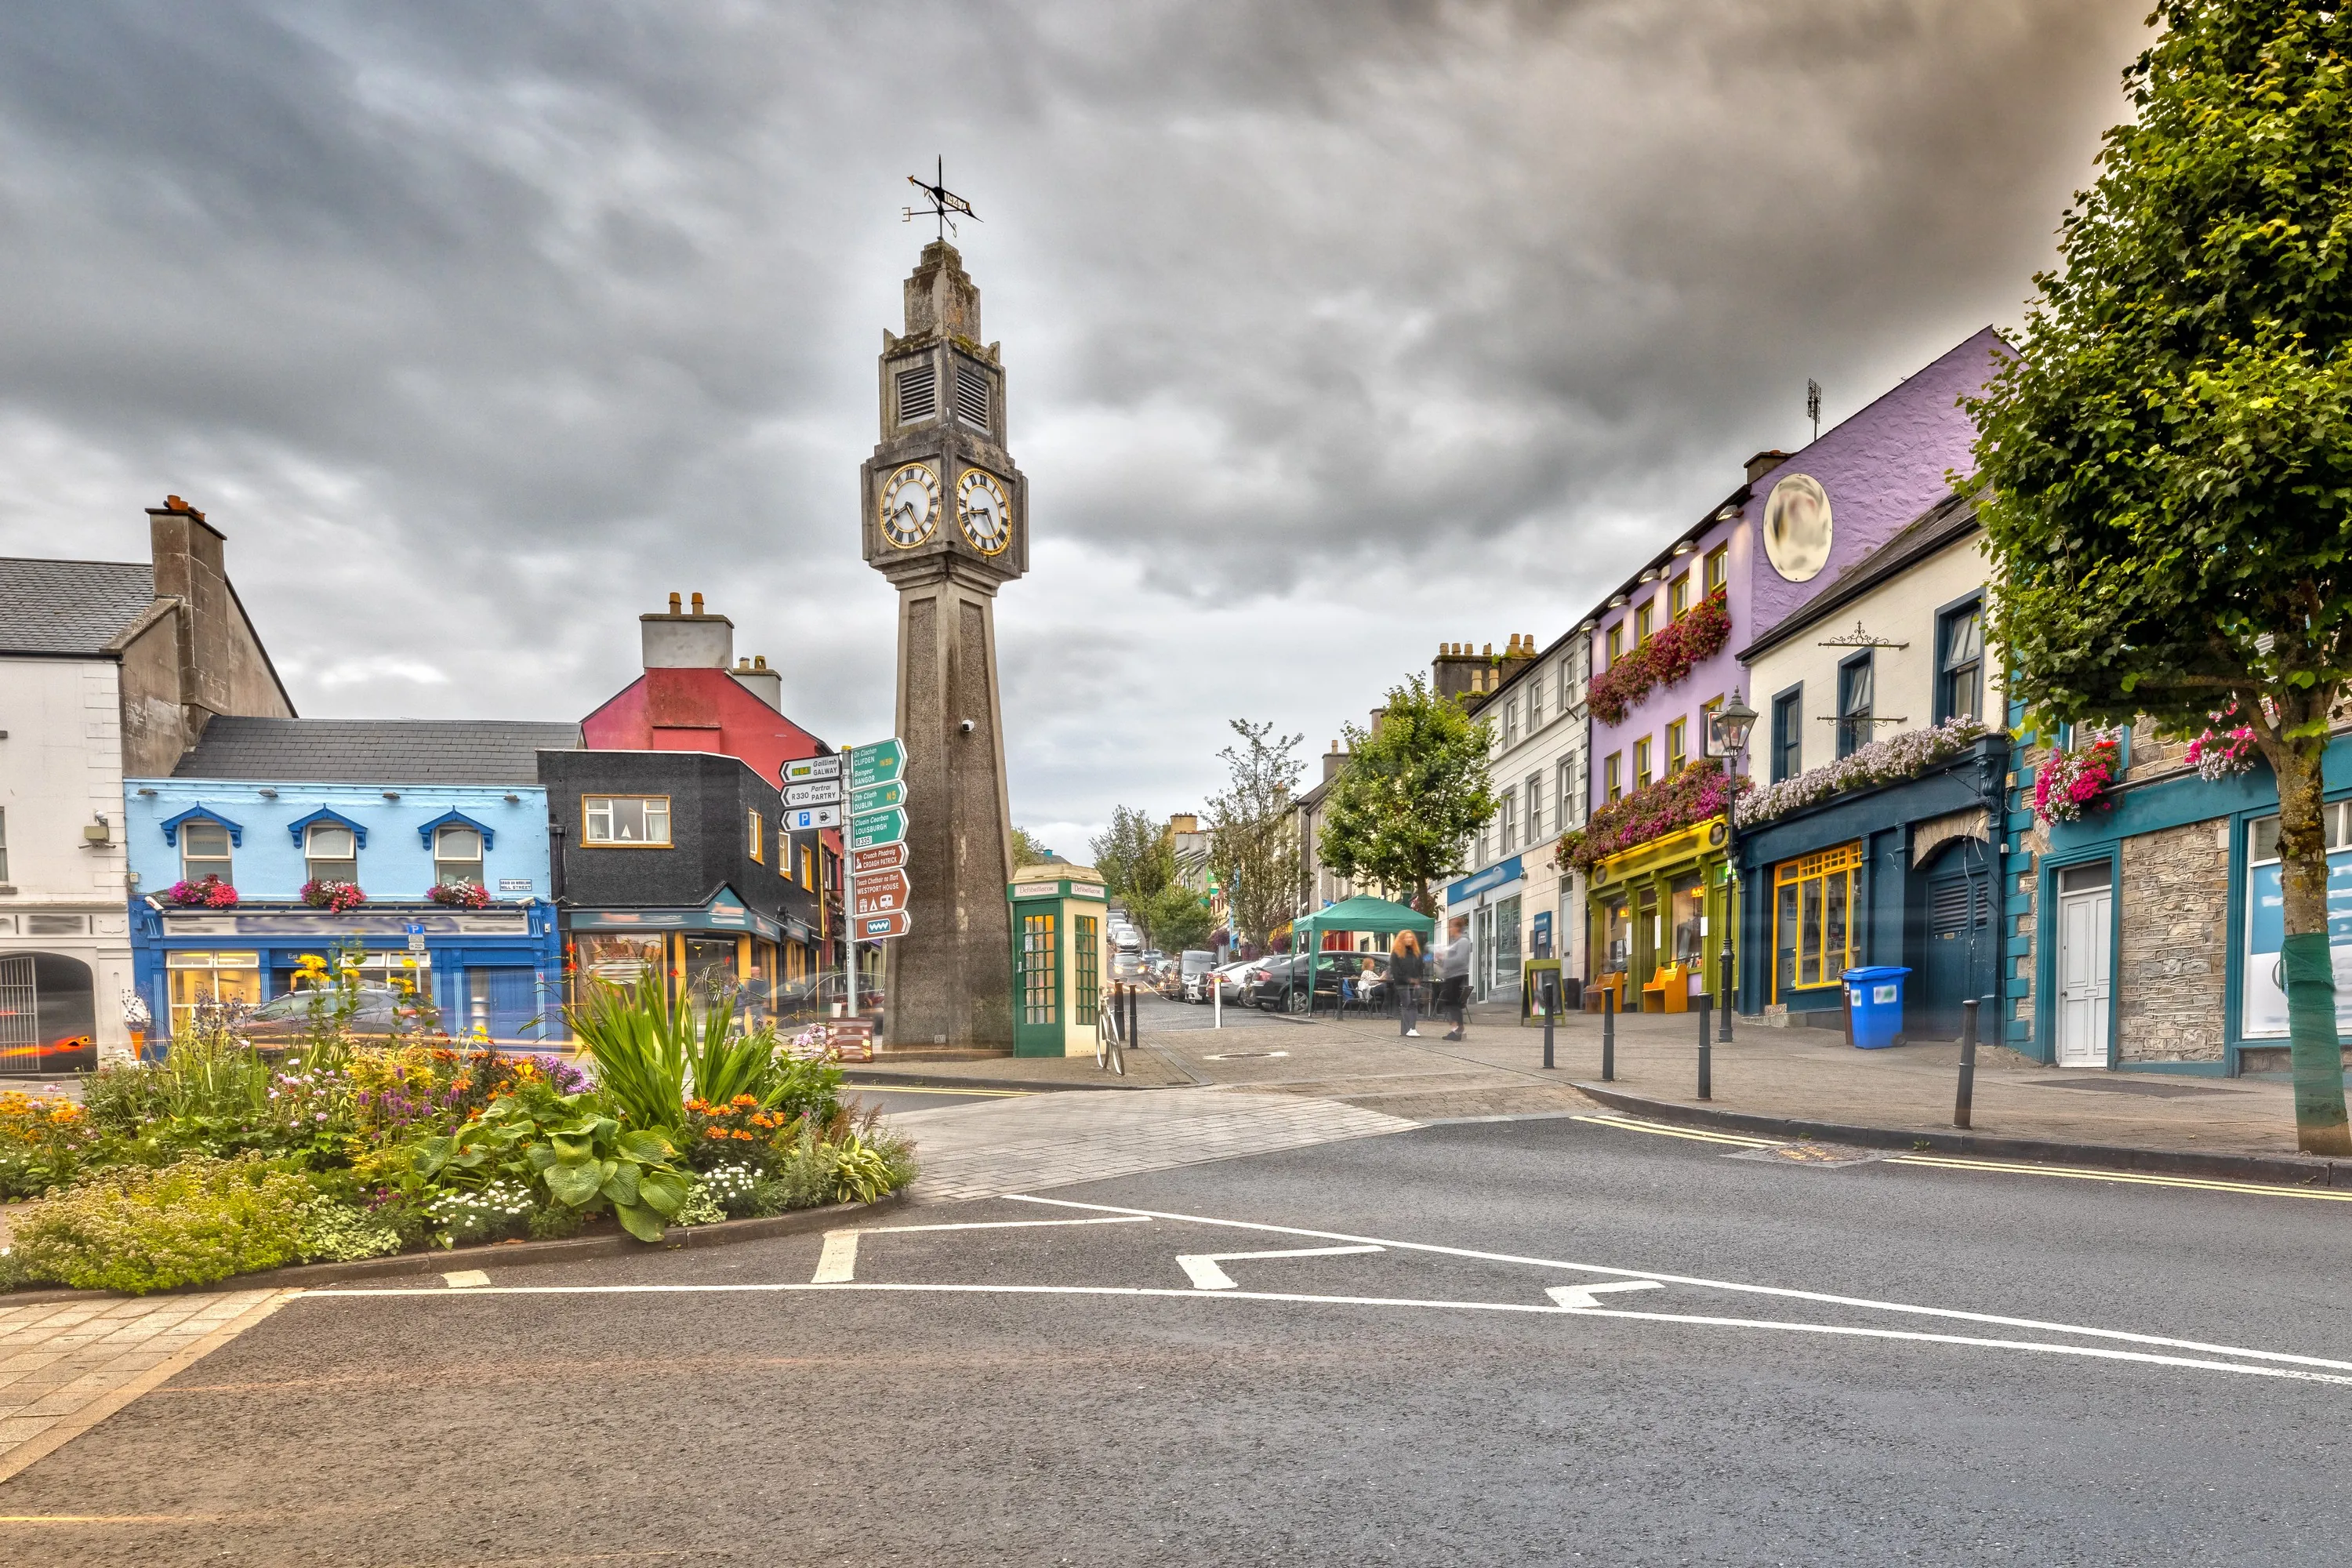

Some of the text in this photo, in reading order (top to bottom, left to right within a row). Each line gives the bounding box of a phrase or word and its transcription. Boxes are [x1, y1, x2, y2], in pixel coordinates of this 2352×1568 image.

[946, 193, 965, 210] 1947
[813, 758, 837, 768] Gaillimh
[854, 756, 875, 766] CLIFDEN
[813, 767, 837, 775] GALWAY
[855, 768, 874, 777] Baingear
[855, 775, 876, 785] BANGOR
[811, 792, 836, 800] PARTRY
[863, 791, 877, 800] Cliath
[855, 800, 873, 810] DUBLIN
[801, 814, 808, 825] P
[855, 823, 887, 835] LOUISBURGH
[863, 857, 898, 868] CROAGH PATRICK
[857, 882, 899, 895] WESTPORT HOUSE
